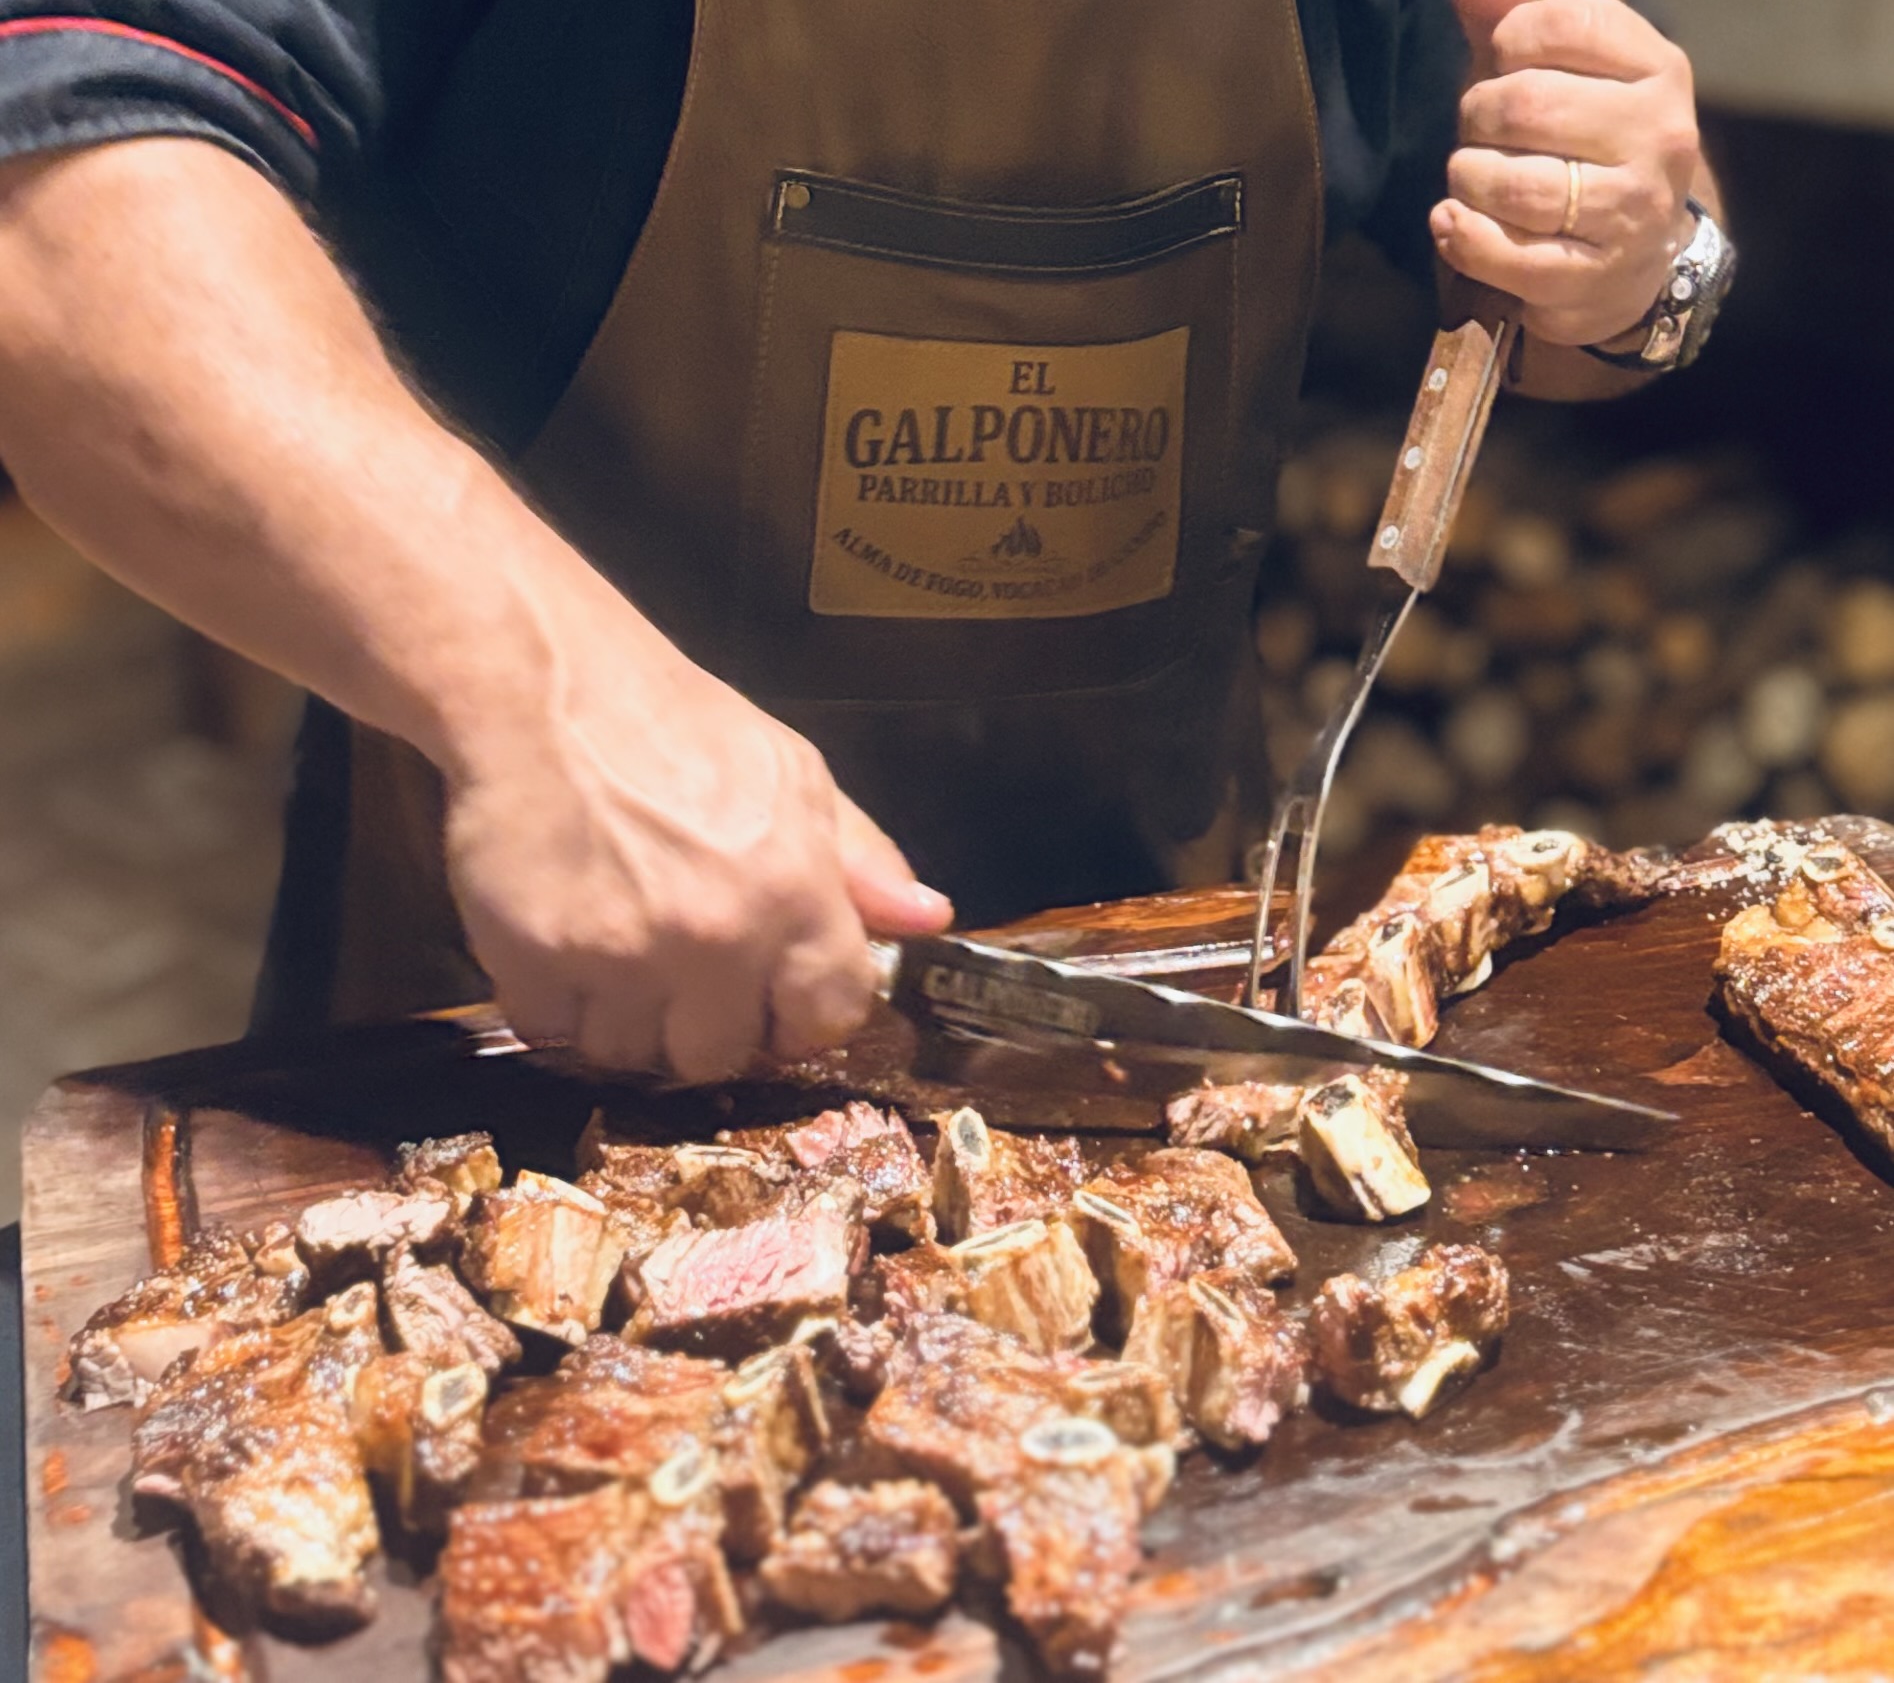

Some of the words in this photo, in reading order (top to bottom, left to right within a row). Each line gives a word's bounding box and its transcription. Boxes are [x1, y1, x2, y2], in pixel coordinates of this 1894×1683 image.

[1009, 360, 1056, 396] EL
[843, 404, 1171, 469] GALPONERO
[856, 473, 1012, 509] PARRILLA
[1018, 480, 1038, 508] Y
[831, 527, 893, 574] ALMA
[893, 562, 925, 588] DE
